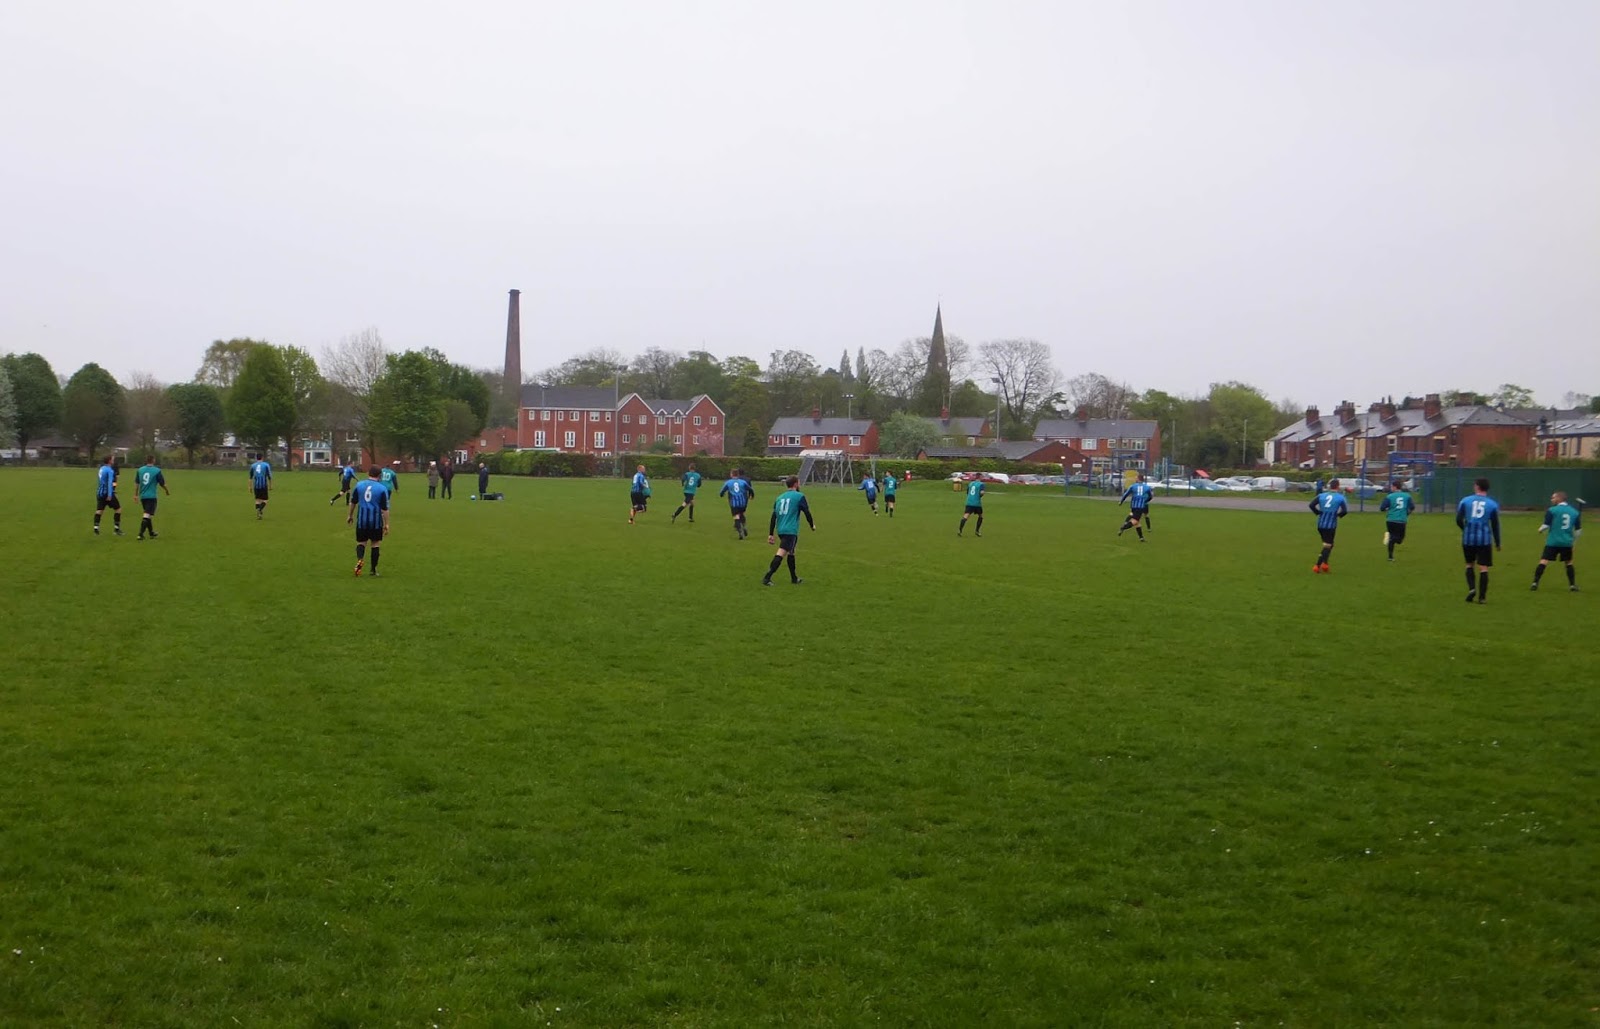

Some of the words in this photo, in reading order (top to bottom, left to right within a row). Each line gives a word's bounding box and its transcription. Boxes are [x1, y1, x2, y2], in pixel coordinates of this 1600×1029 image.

[256, 464, 261, 474] 4
[142, 472, 150, 485] 9
[382, 471, 391, 481] 10
[733, 482, 740, 493] 8
[888, 480, 894, 488] 2
[365, 486, 372, 502] 6
[970, 485, 976, 496] 8
[1137, 485, 1144, 496] 11
[780, 498, 790, 515] 11
[1325, 495, 1333, 508] 2
[1396, 497, 1405, 509] 5
[1471, 500, 1486, 518] 15
[1561, 513, 1571, 530] 3
